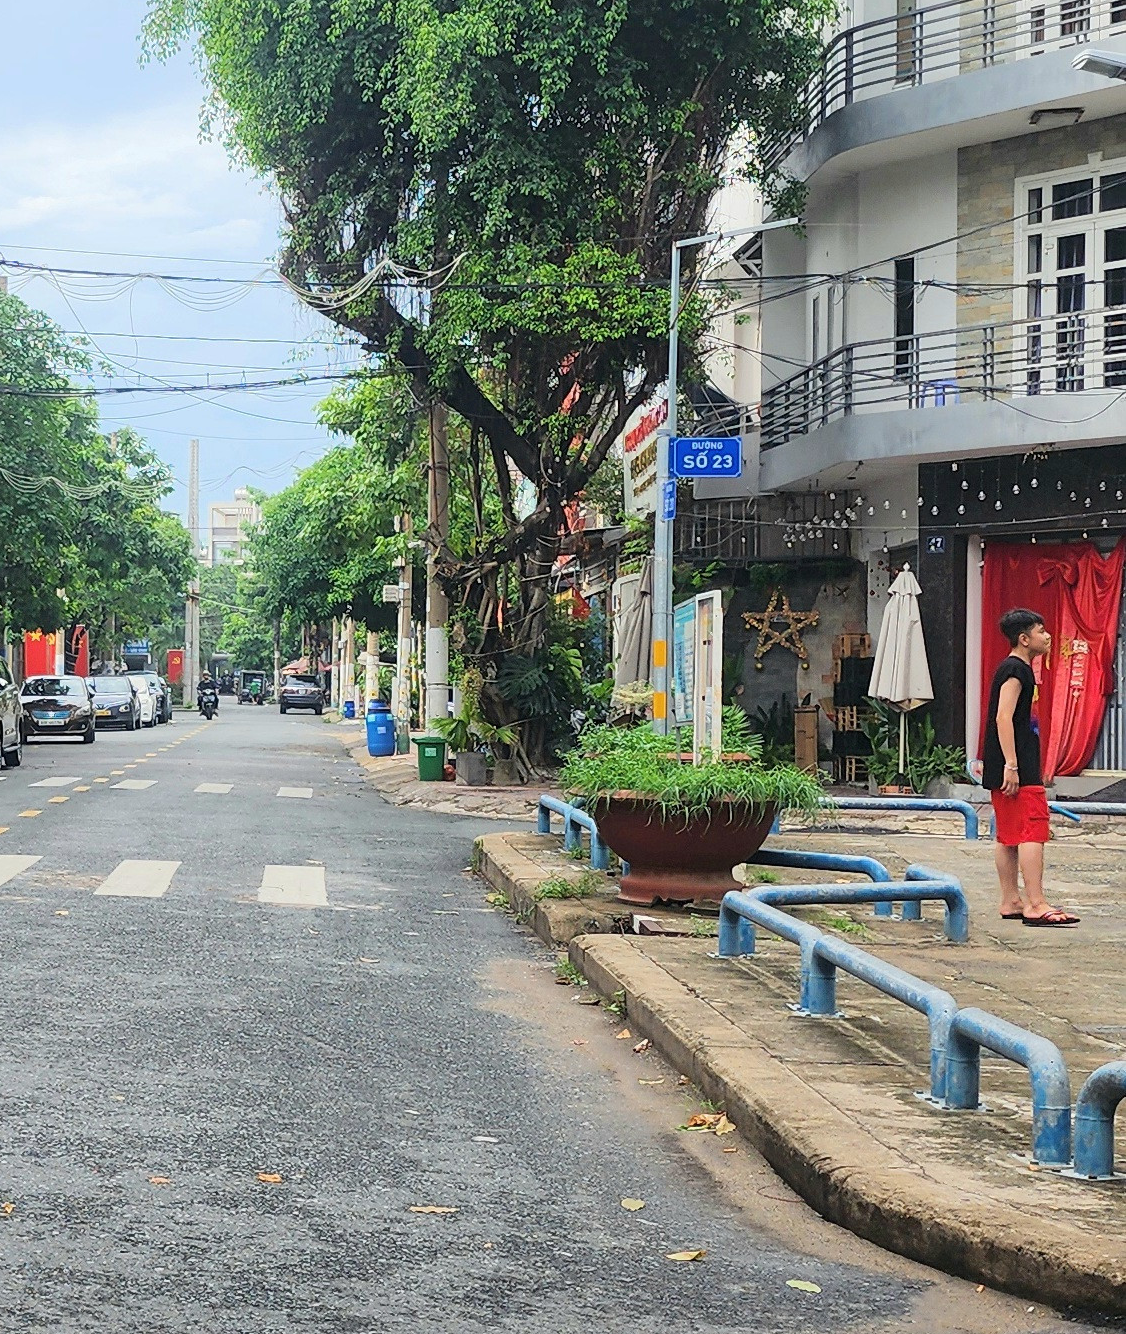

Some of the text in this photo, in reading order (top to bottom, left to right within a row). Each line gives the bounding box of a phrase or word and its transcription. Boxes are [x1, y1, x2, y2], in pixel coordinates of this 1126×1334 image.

[692, 440, 723, 450] ĐƯỜNG
[683, 450, 733, 469] SỐ 23
